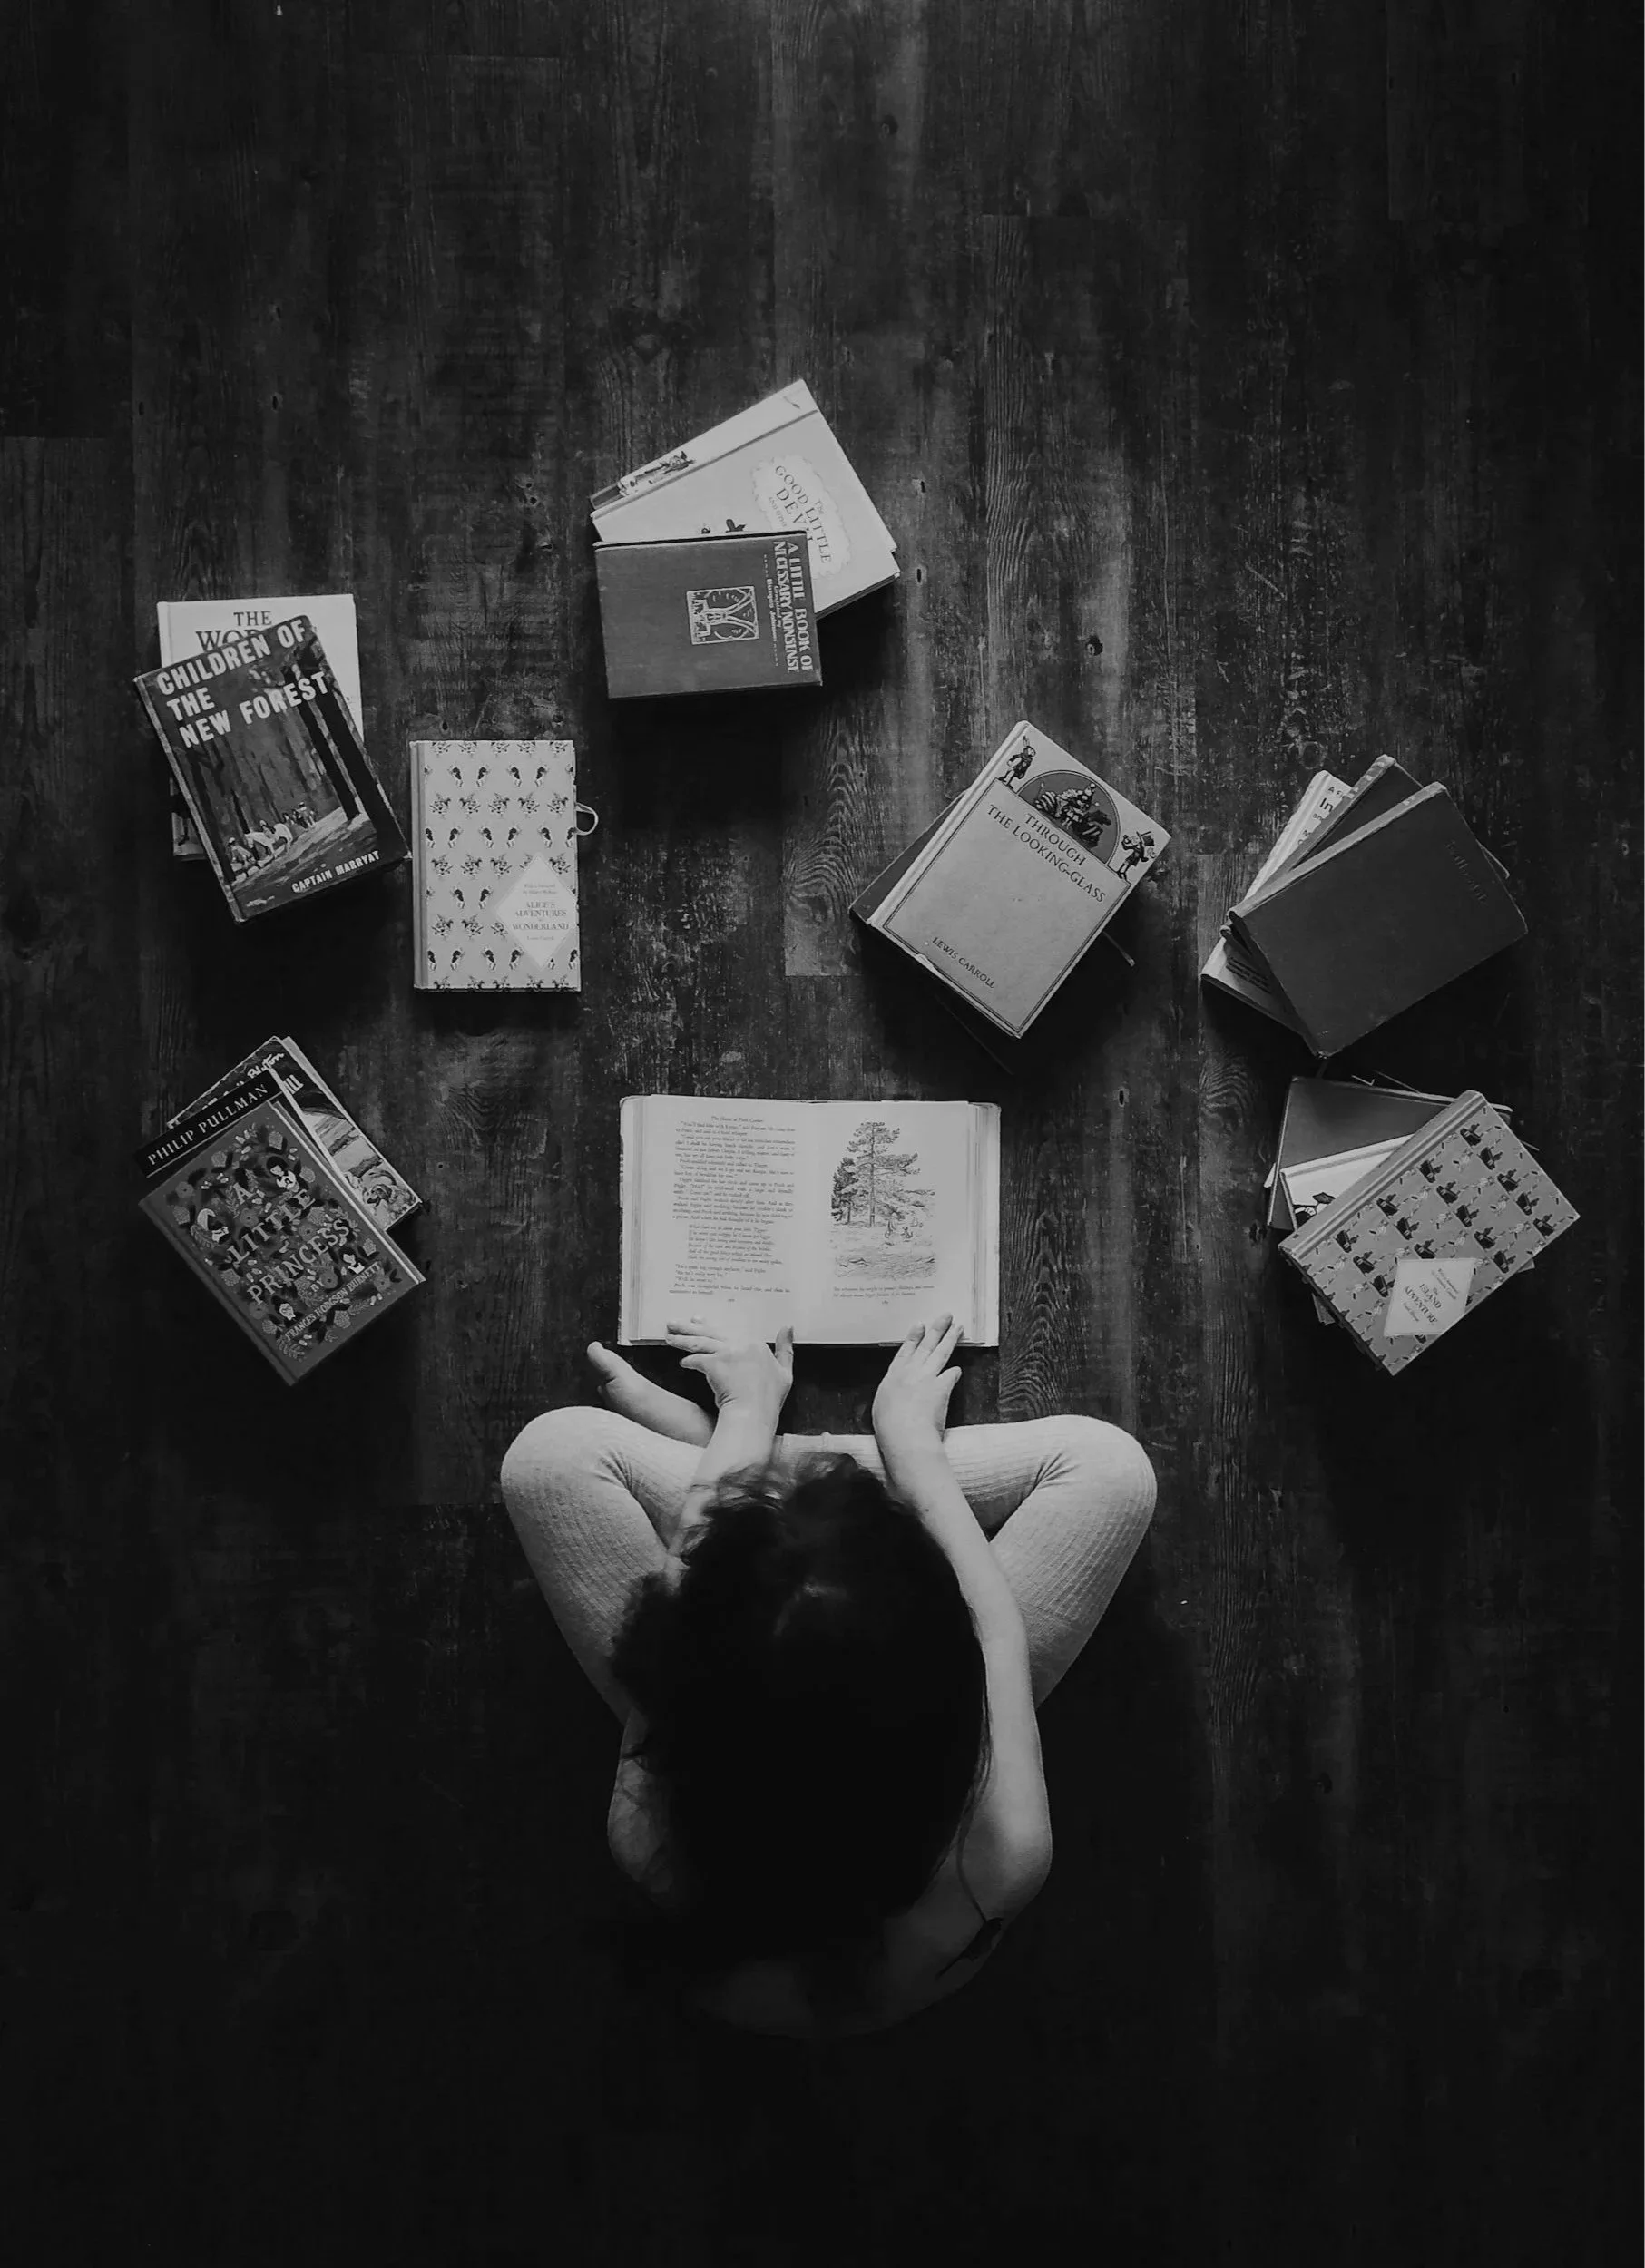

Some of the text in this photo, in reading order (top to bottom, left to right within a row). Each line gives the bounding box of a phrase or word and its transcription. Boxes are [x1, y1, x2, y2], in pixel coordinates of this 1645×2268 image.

[776, 465, 831, 563] GOOD LITTLE
[233, 611, 272, 626] THE
[773, 541, 799, 673] NECESSARY NONSENSE
[787, 542, 814, 670] A LITTLE BOOK OF
[156, 619, 306, 696] CHILDREN OF
[166, 687, 215, 721] THE
[179, 671, 328, 748] NEW FOREST
[291, 850, 380, 894] CAPTAIN MARRYAT
[987, 804, 1106, 903] THE LOOKING-GLASS
[1024, 813, 1087, 866] THROUGH
[512, 923, 570, 931] WONDERLAND
[932, 937, 995, 989] LEWIS CARROLL
[147, 1129, 195, 1166] PHILIP
[198, 1084, 269, 1134] PULLMAN
[227, 1188, 316, 1265] LITTLE
[232, 1182, 254, 1205] A
[247, 1219, 350, 1306] PRINCESS
[284, 1261, 382, 1341] FRANCES HODGSON BURNETT
[1419, 1283, 1442, 1309] ISLAND
[1405, 1286, 1438, 1323] ADVENTURE
